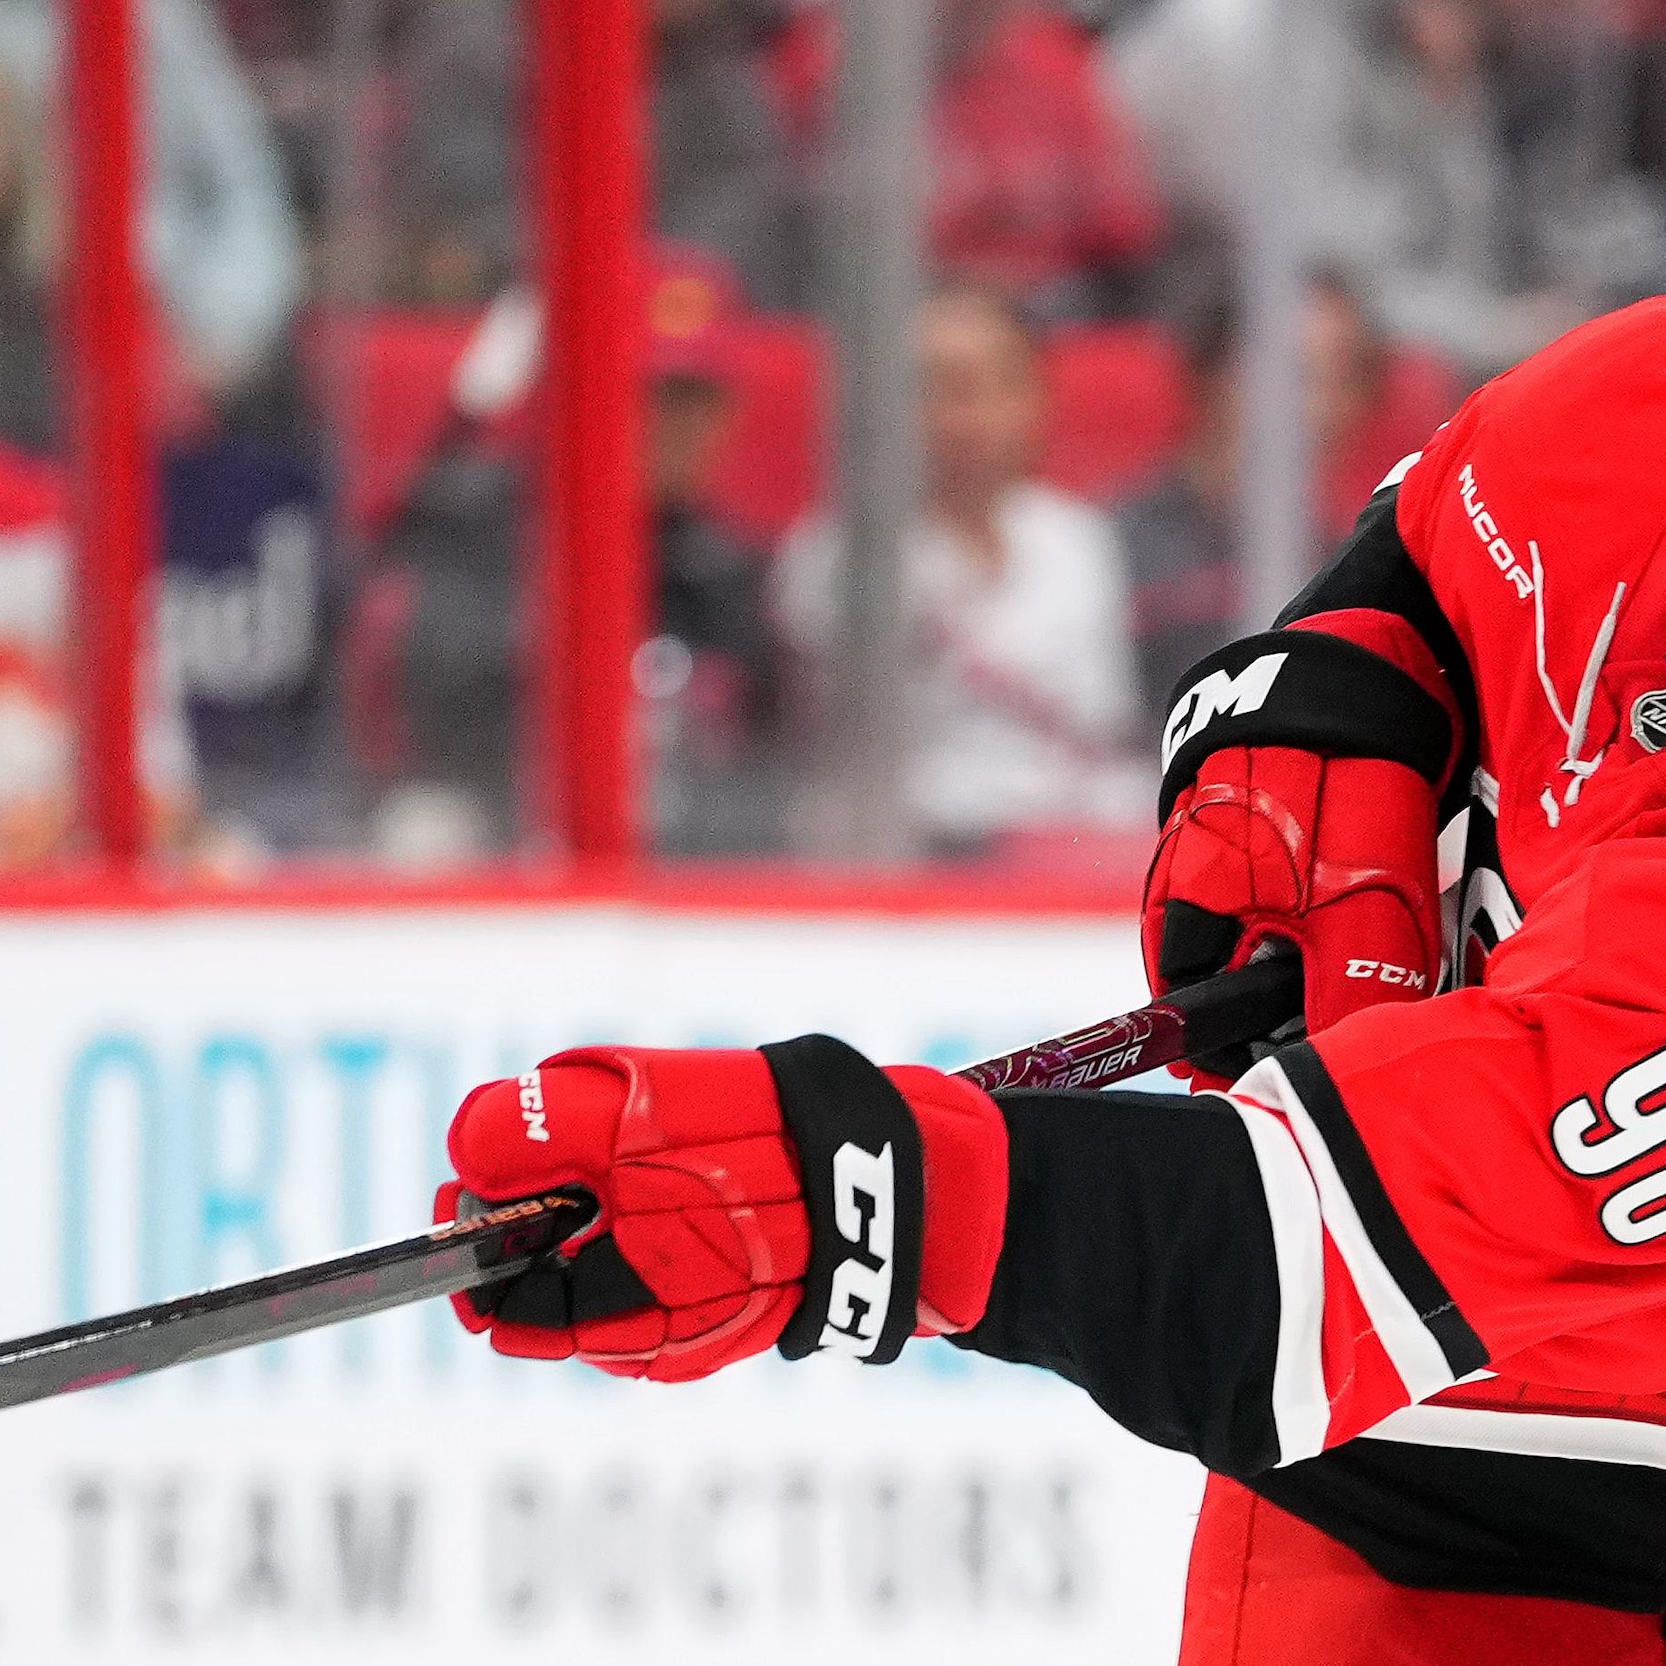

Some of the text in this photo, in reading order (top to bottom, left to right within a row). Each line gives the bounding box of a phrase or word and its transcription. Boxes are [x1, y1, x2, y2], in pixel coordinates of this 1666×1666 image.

[1457, 463, 1534, 599] NUCOR
[1344, 958, 1427, 990] CCM
[517, 1067, 551, 1143] CCM
[61, 1476, 431, 1642] TEAM
[485, 1466, 1093, 1636] DOCTORS
